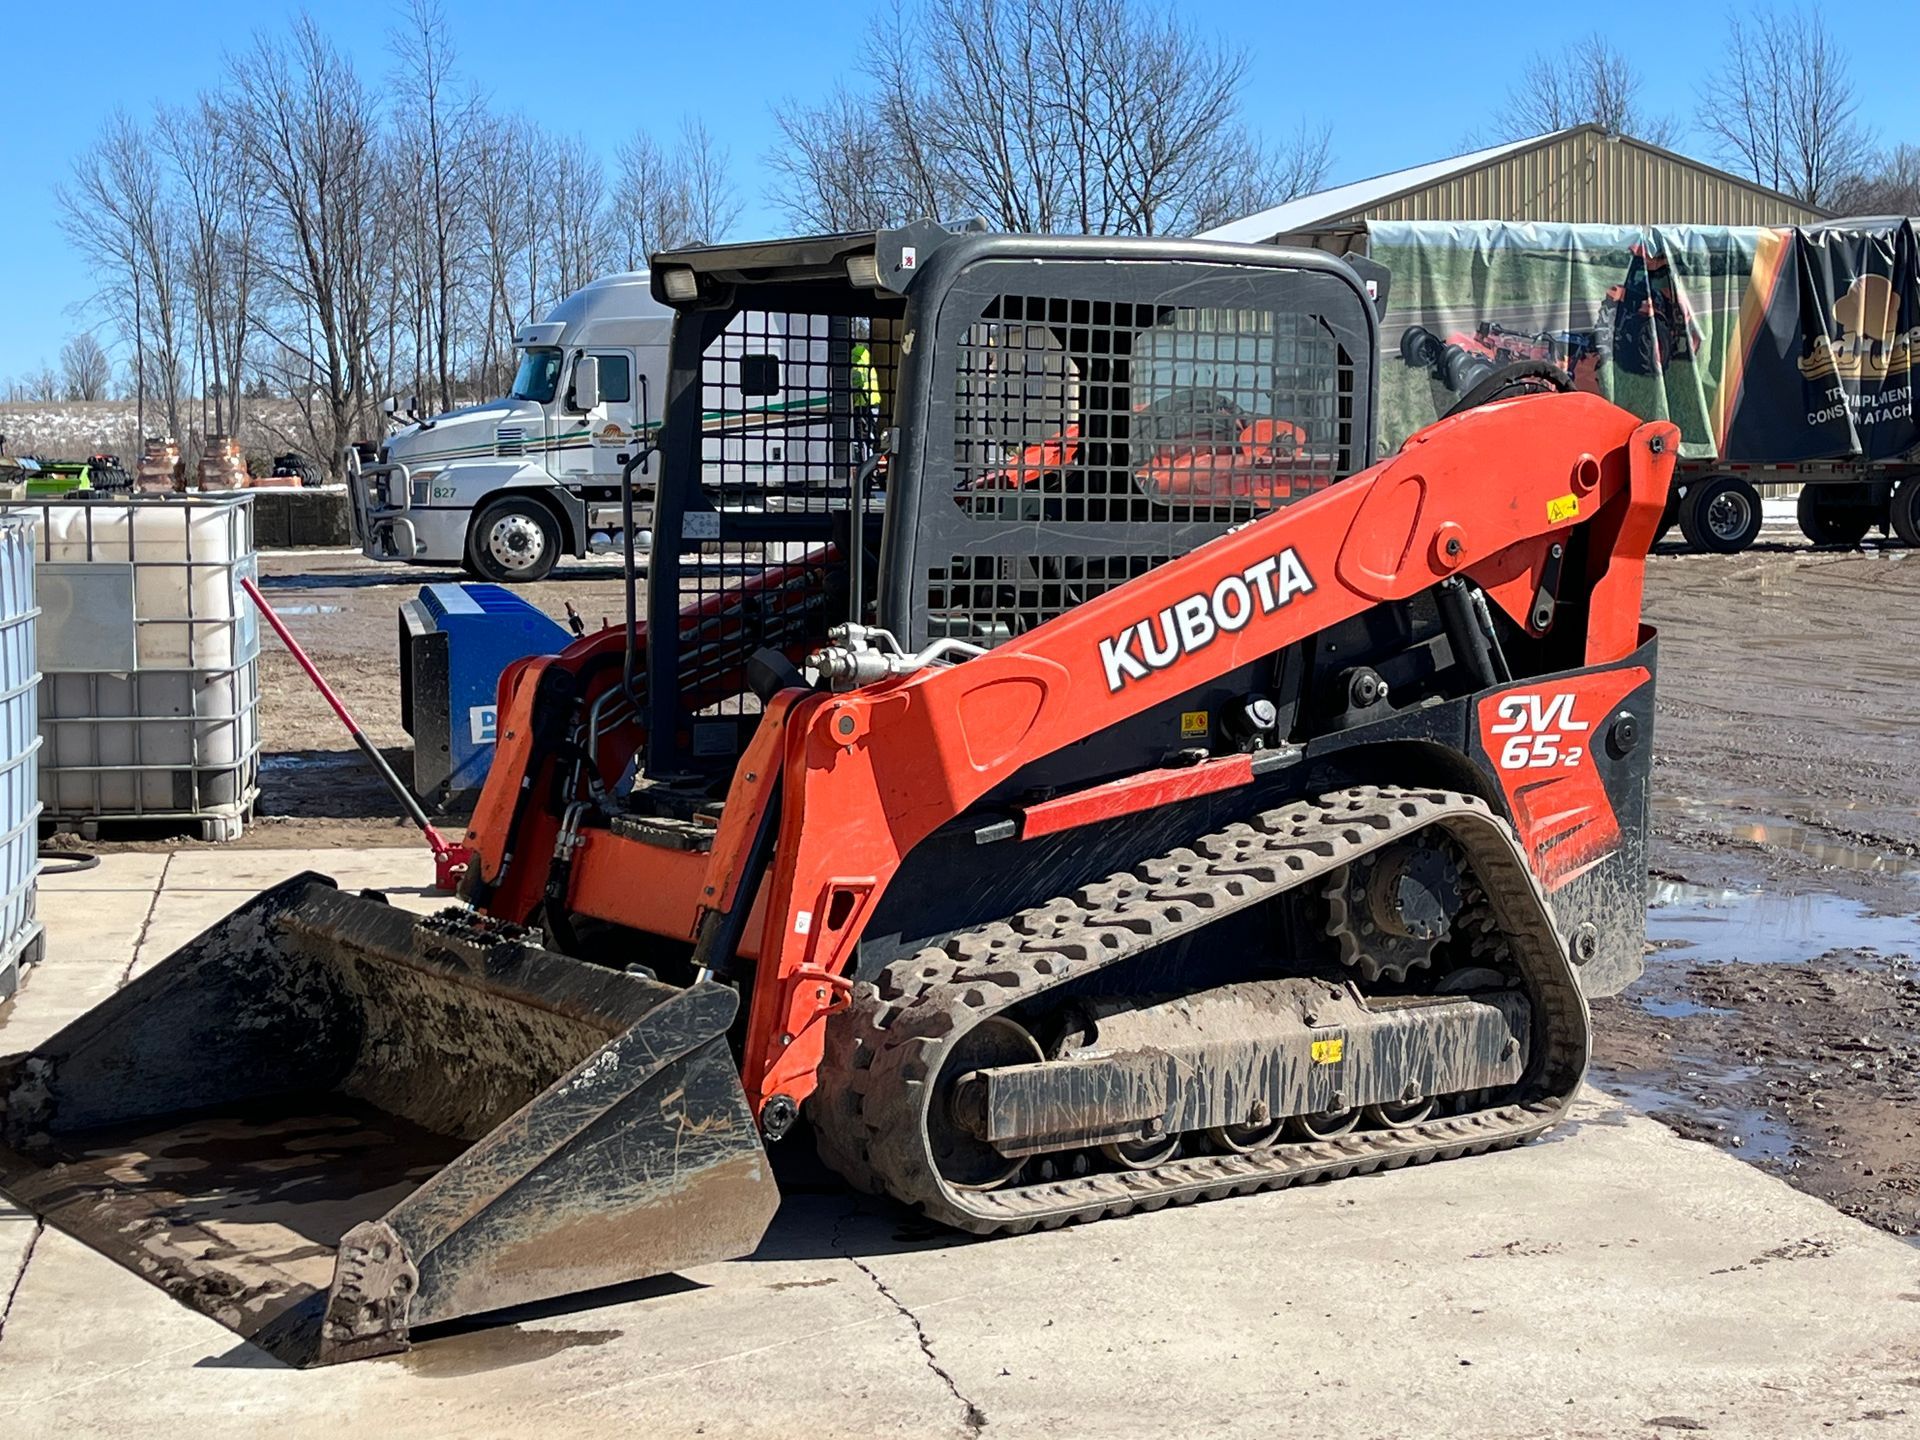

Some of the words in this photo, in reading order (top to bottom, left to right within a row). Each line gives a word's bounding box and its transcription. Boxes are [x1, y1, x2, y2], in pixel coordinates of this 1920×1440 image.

[433, 487, 457, 498] 827
[1098, 546, 1315, 692] KUBOTA
[1491, 693, 1590, 734] SVL
[1500, 734, 1583, 769] 65-2
